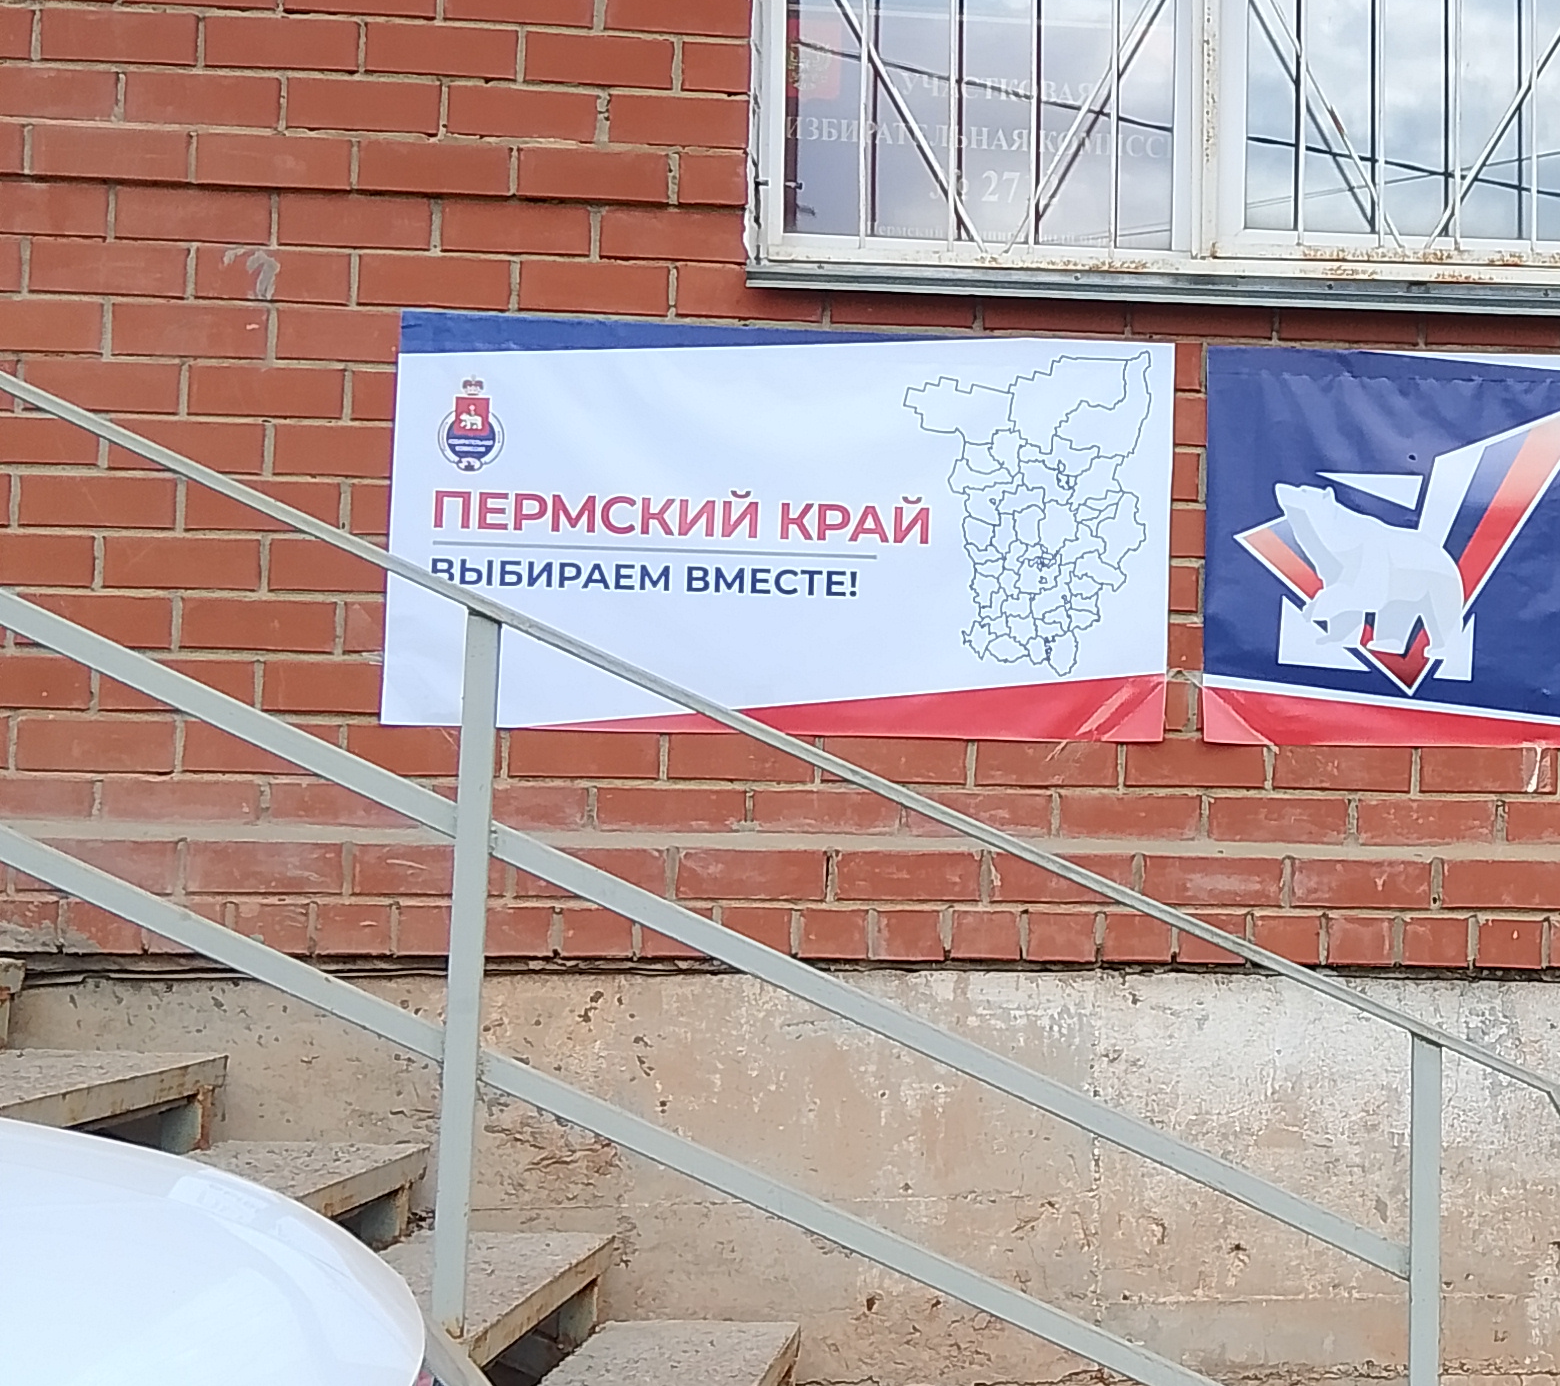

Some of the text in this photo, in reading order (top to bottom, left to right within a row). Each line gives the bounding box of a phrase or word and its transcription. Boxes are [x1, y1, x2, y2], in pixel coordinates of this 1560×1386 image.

[432, 490, 931, 546] ПЕРМСКИЙ КРАЙ
[431, 557, 858, 598] ВЫБИРАЕМ ВМЕСТЕ!
